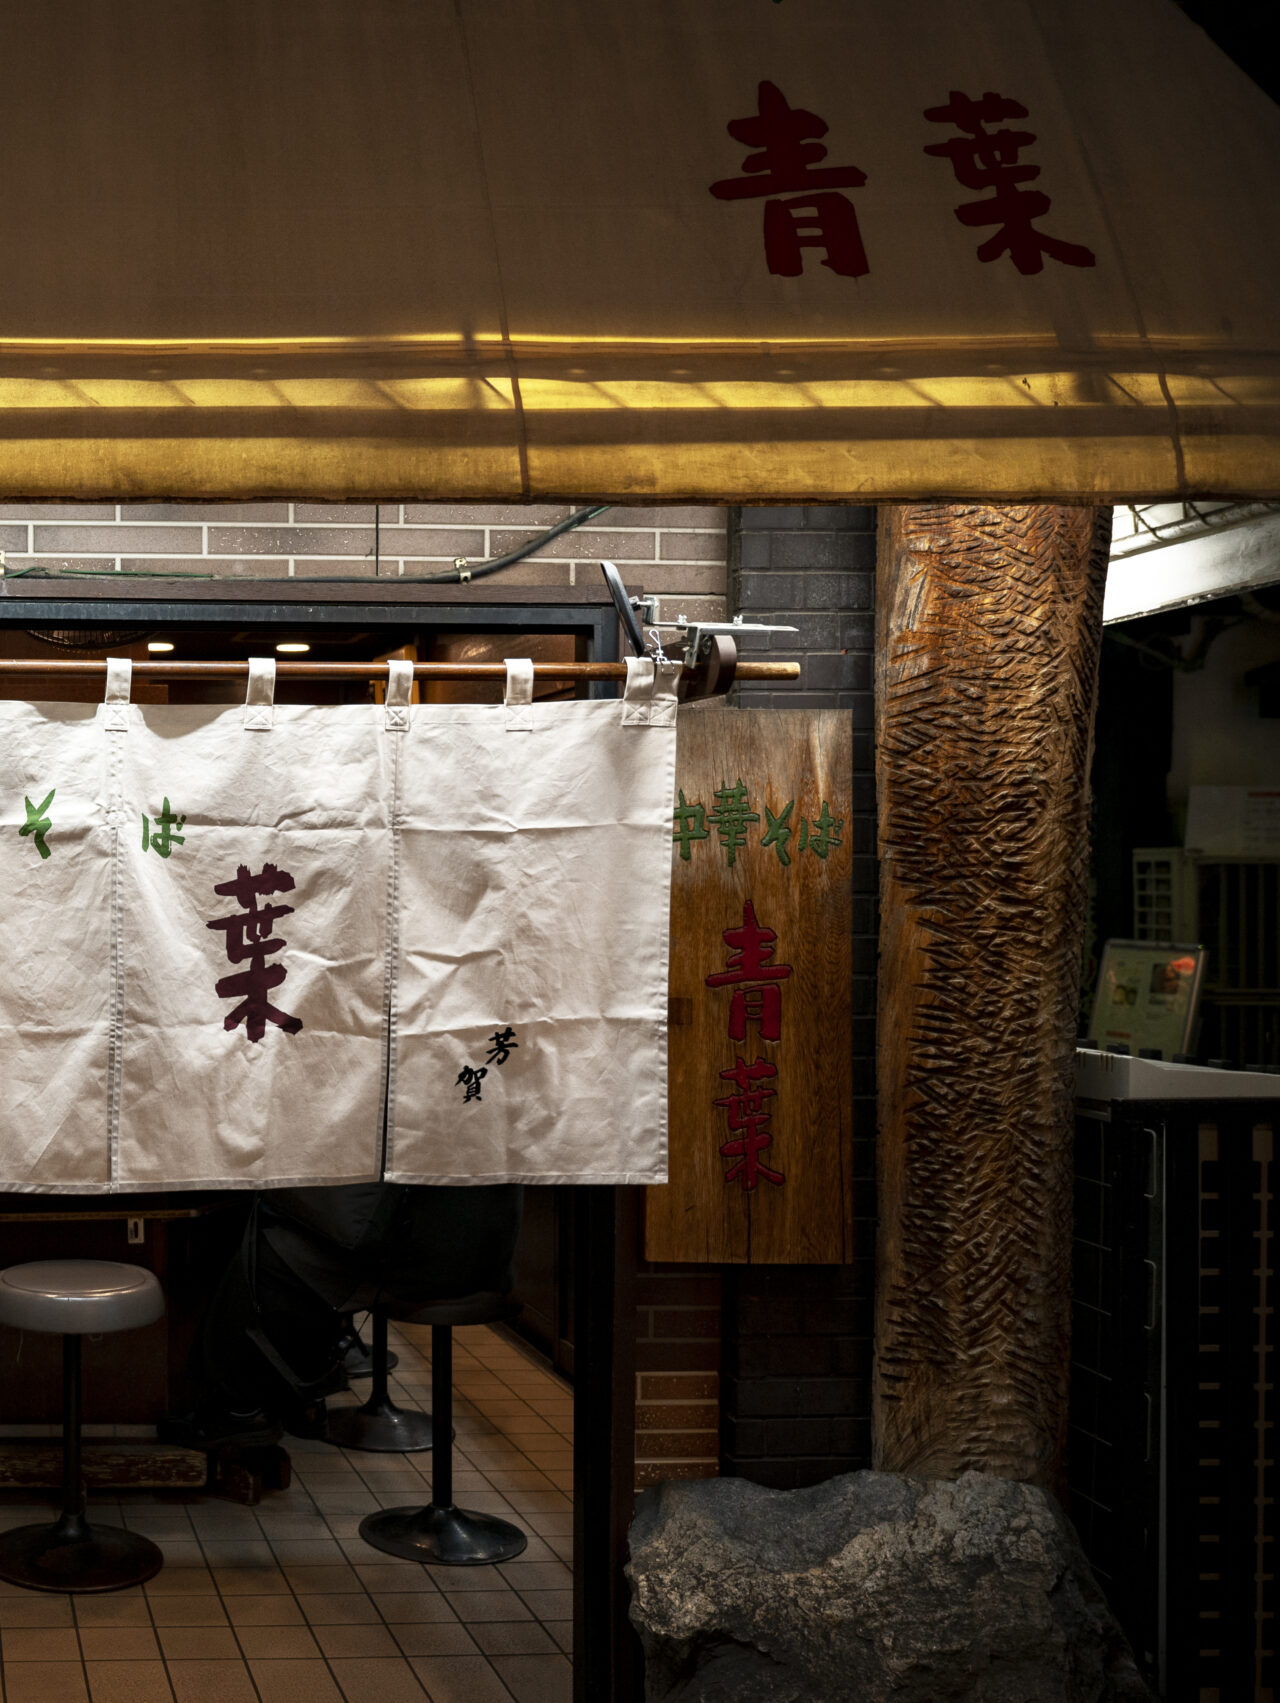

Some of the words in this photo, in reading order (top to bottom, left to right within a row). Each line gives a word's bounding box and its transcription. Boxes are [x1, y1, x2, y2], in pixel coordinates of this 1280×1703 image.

[709, 80, 1096, 277] 青葉
[672, 779, 844, 867] 中華そば
[206, 863, 303, 1043] 葉
[705, 899, 794, 1193] 青葉
